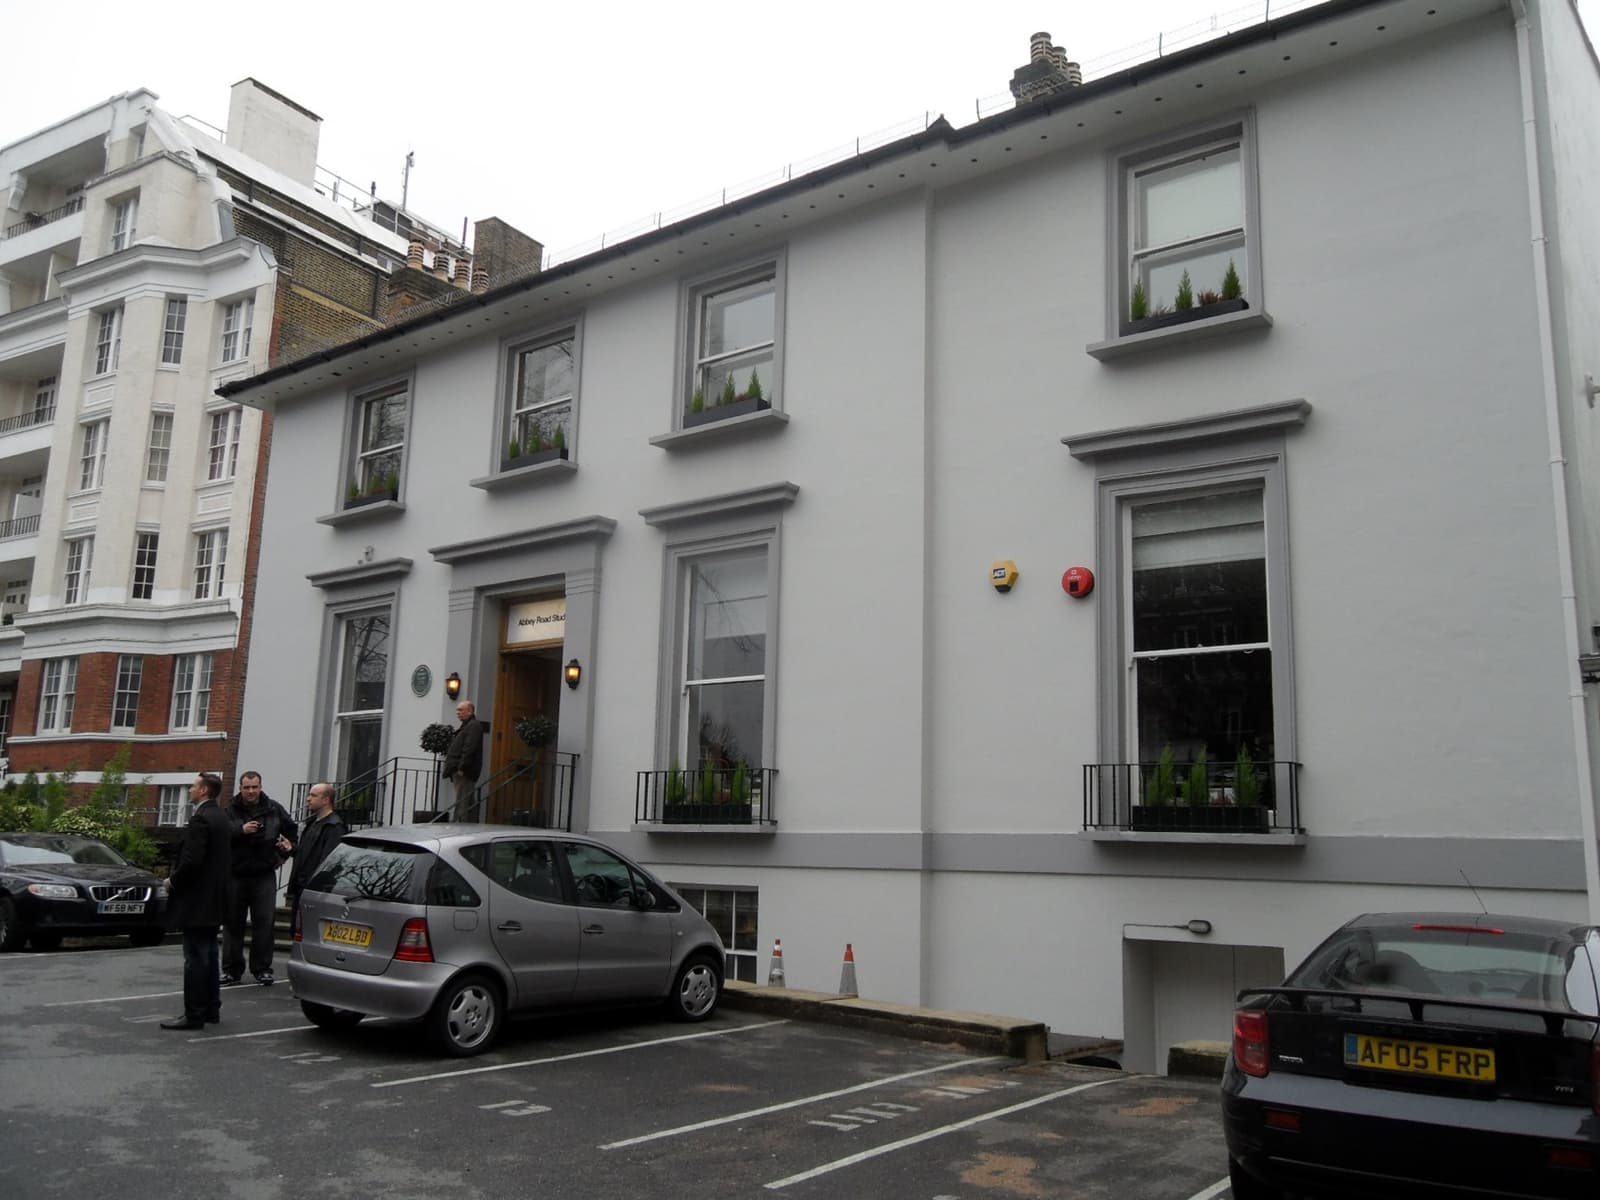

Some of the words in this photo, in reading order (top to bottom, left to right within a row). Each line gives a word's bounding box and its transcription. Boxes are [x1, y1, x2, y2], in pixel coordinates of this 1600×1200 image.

[519, 618, 535, 626] Abbey
[536, 616, 551, 624] Road
[1361, 1039, 1428, 1070] AF05
[1437, 1048, 1489, 1076] FRP
[477, 1100, 552, 1116] 13
